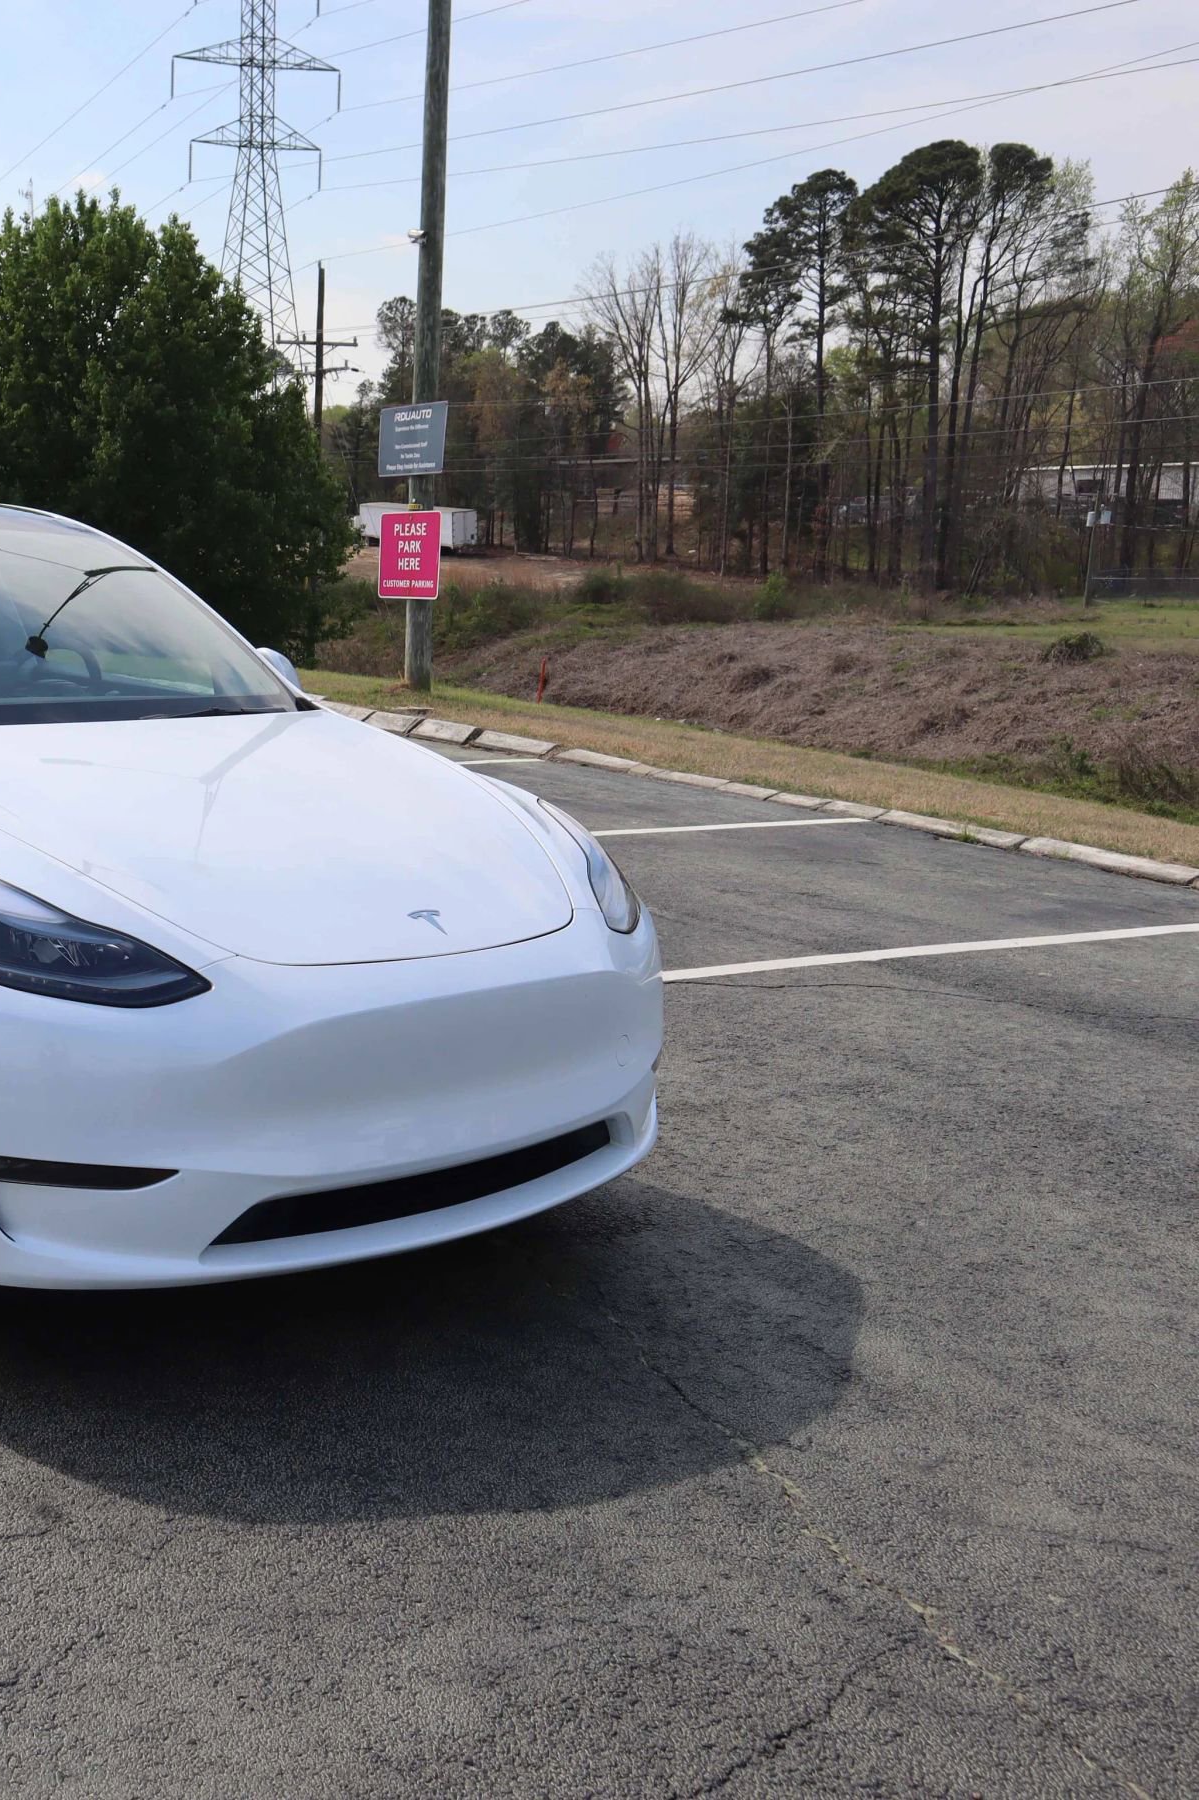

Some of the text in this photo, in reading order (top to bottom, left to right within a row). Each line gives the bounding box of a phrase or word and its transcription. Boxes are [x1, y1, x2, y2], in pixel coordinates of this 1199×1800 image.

[394, 523, 427, 536] PLEASE
[398, 540, 421, 553] PARK
[398, 558, 420, 570] HERE
[383, 580, 434, 588] CUSTOMER PARKING
